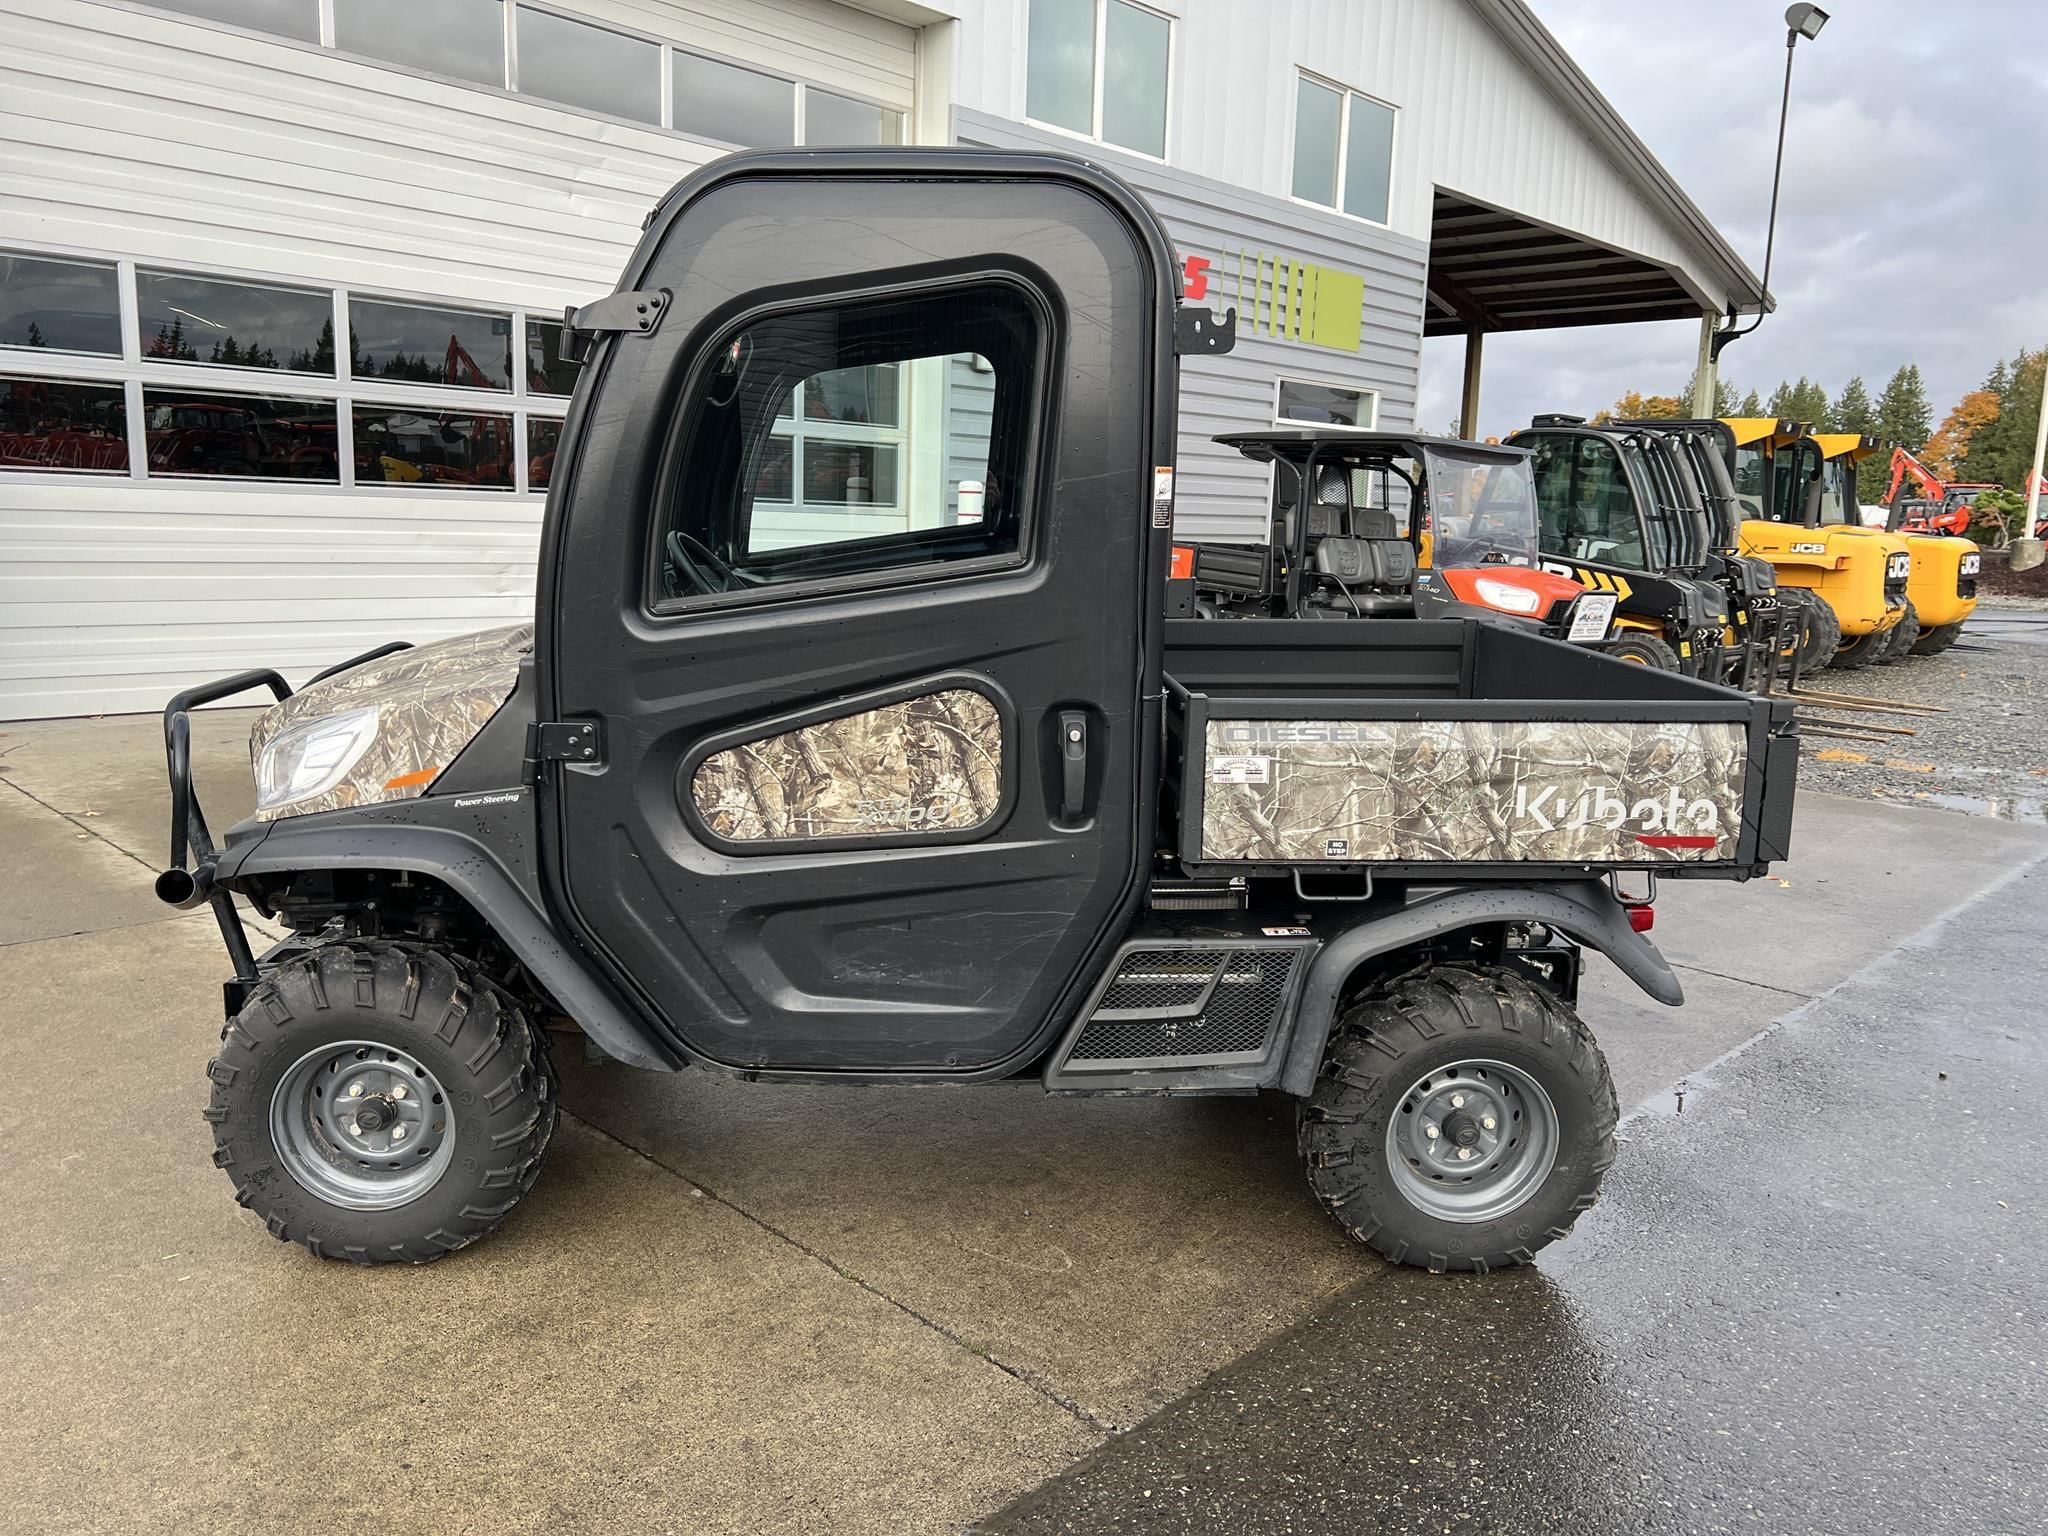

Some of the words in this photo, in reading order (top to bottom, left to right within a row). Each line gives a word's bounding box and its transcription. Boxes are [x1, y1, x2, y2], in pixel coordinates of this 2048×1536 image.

[1790, 543, 1825, 554] JCB
[1888, 556, 1910, 578] JCB
[1961, 555, 1980, 575] JCB
[1225, 727, 1387, 742] DIESEL
[454, 799, 482, 808] Power
[482, 793, 519, 804] Steering
[1516, 785, 1718, 831] Kubota
